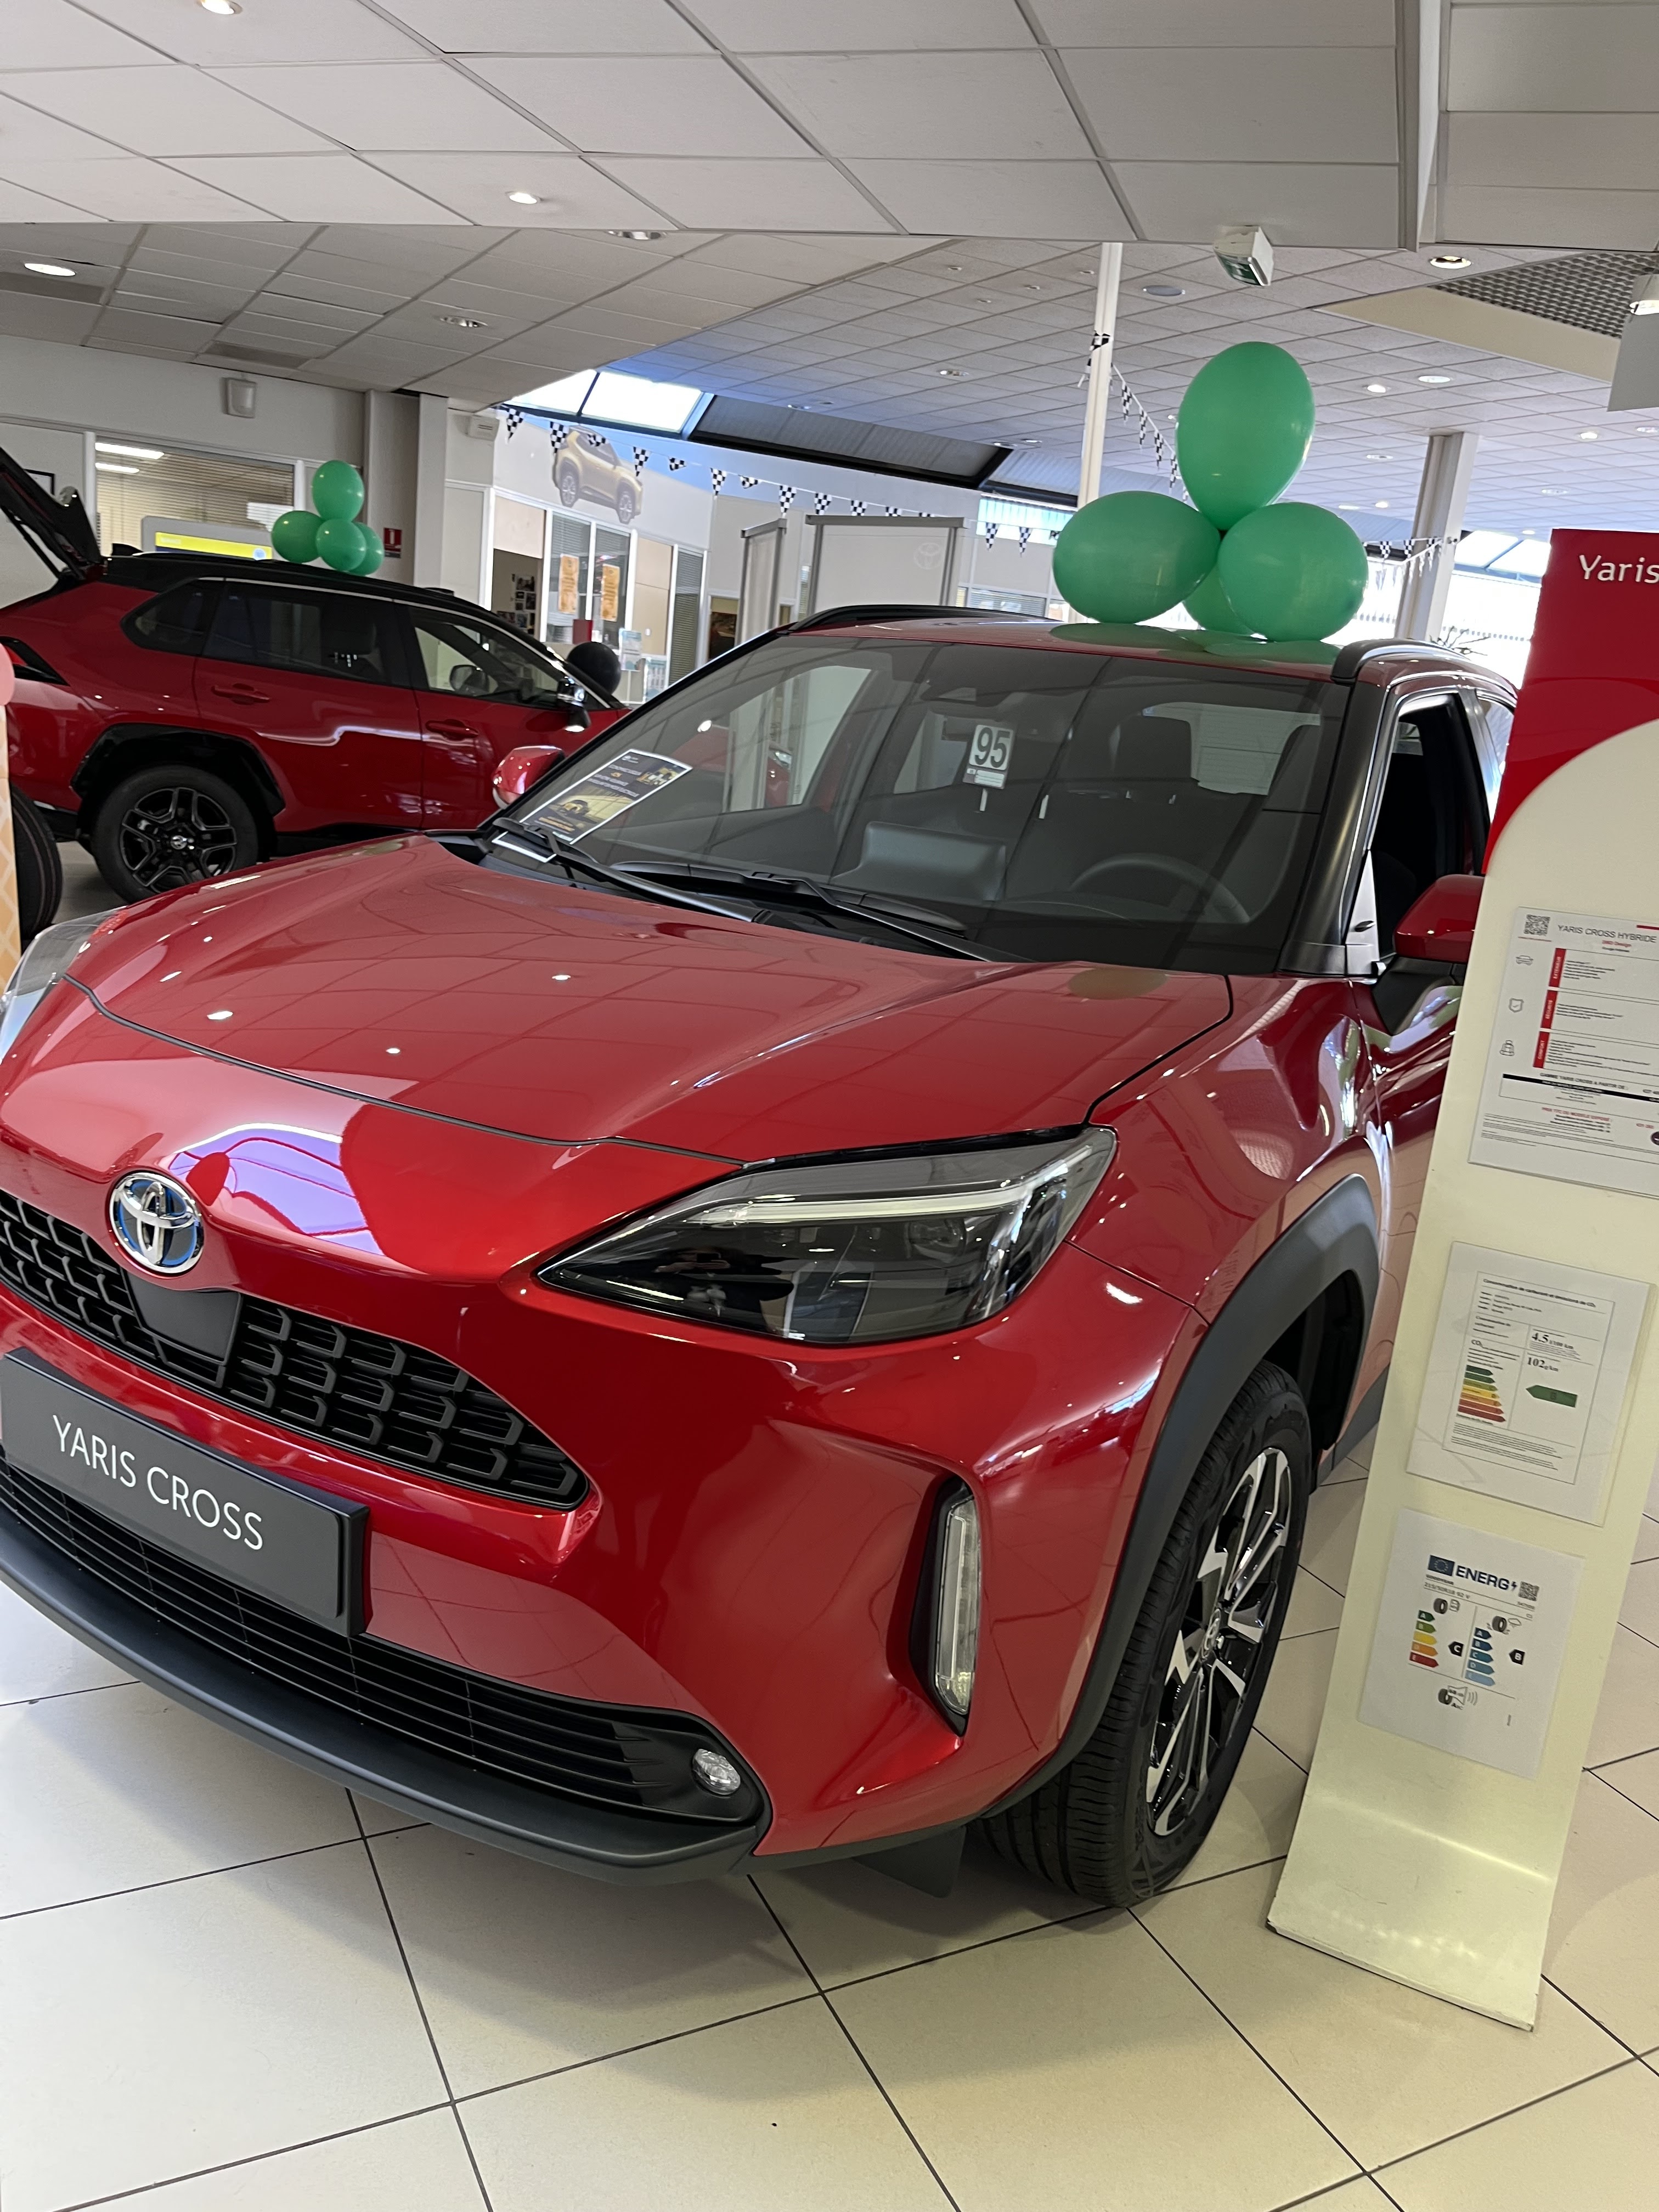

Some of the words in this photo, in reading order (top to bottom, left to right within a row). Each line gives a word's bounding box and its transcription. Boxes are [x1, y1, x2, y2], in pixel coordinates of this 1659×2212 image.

[1579, 555, 1659, 584] Yaris
[974, 727, 1011, 768] 95
[1558, 924, 1583, 934] YARIS
[1585, 928, 1616, 938] CROSS
[1618, 932, 1657, 943] HYBRIDE
[1527, 1356, 1545, 1368] 102
[53, 1415, 137, 1487] YARIS
[146, 1466, 264, 1550] CROSS
[1455, 1565, 1510, 1590] ENERG
[1454, 1645, 1461, 1653] C
